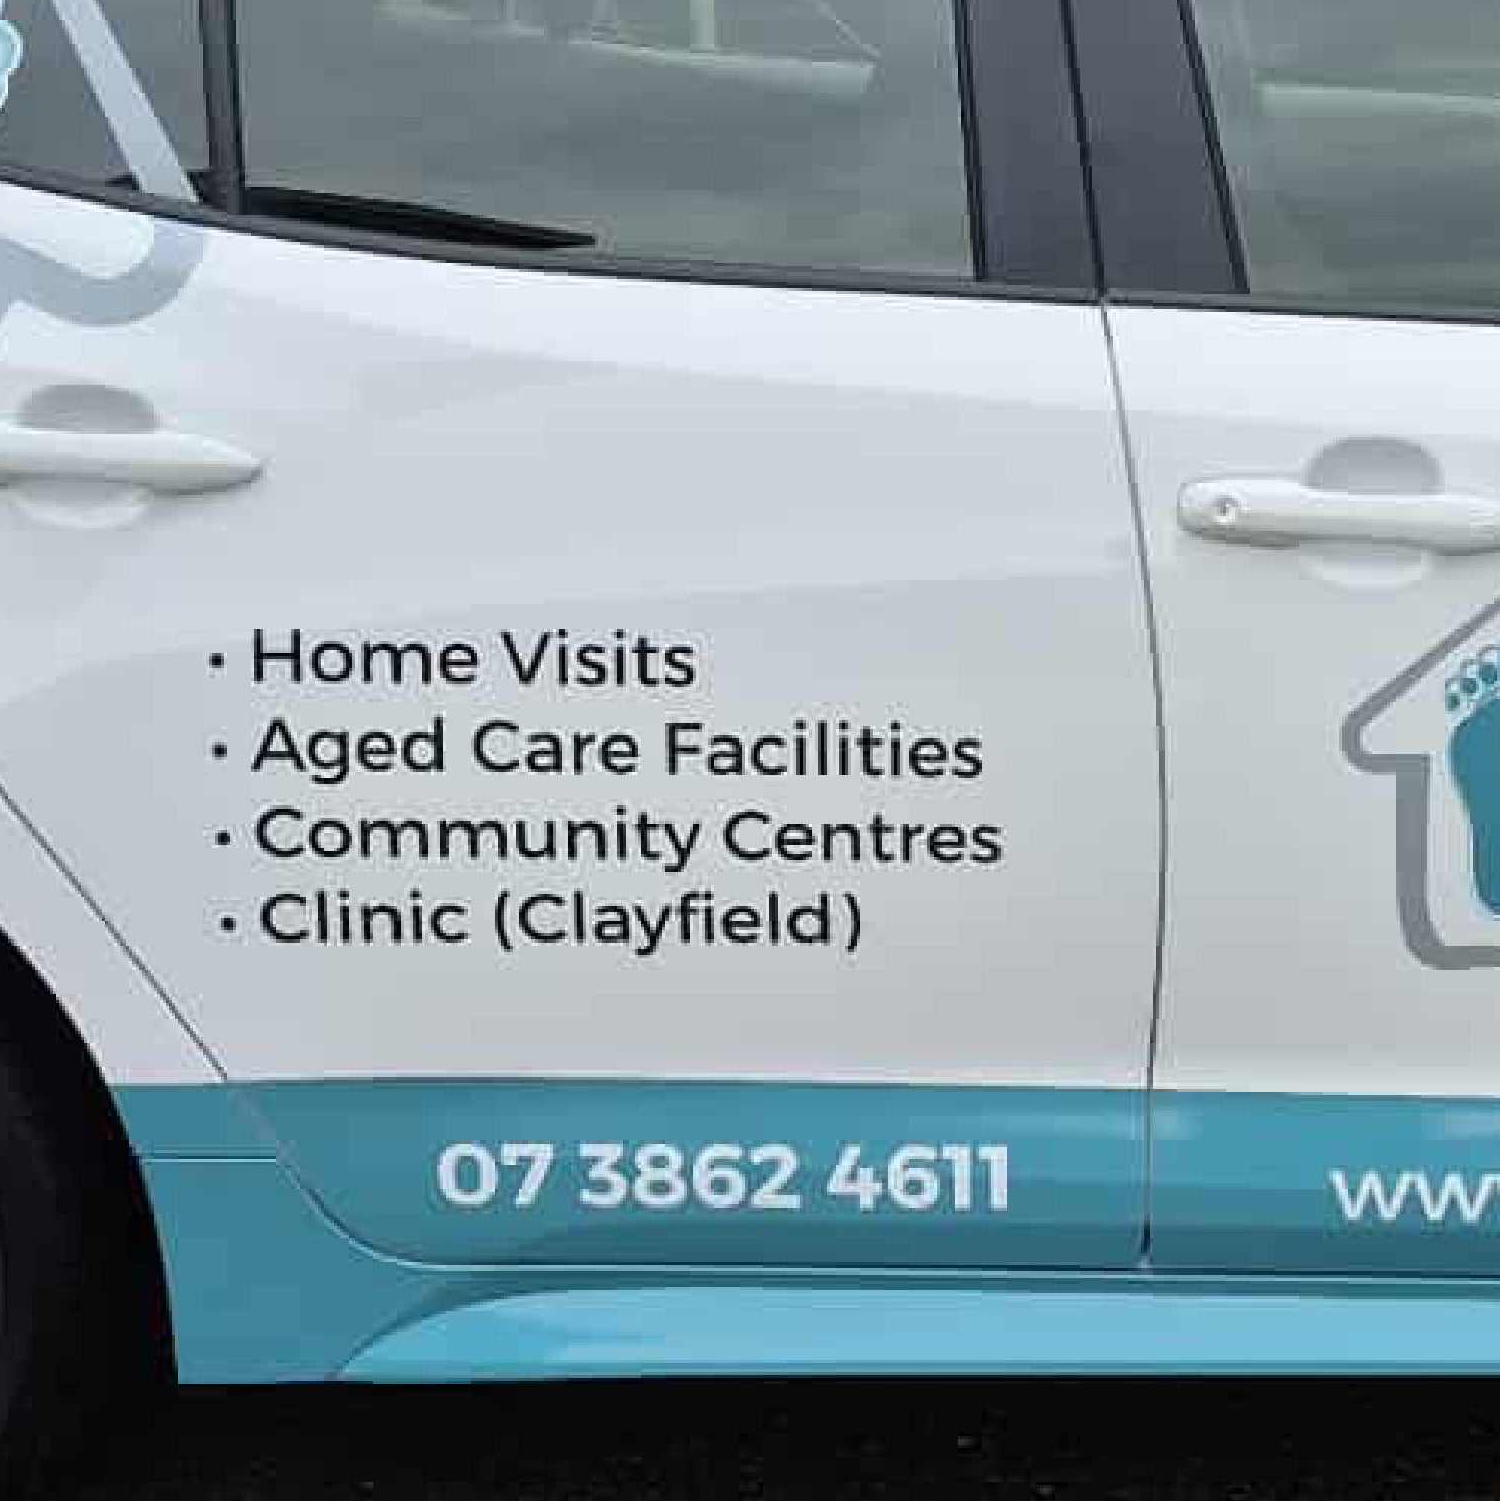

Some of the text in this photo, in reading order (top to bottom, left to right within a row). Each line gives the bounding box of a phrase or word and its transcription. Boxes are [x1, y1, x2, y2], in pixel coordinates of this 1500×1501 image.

[252, 627, 698, 688] Home Visits
[250, 716, 984, 785] Aged Care Facilities
[253, 804, 1003, 873] Community Centres
[259, 888, 862, 956] Clinic (Clayfield)
[438, 1143, 1009, 1209] 07 3862 4611
